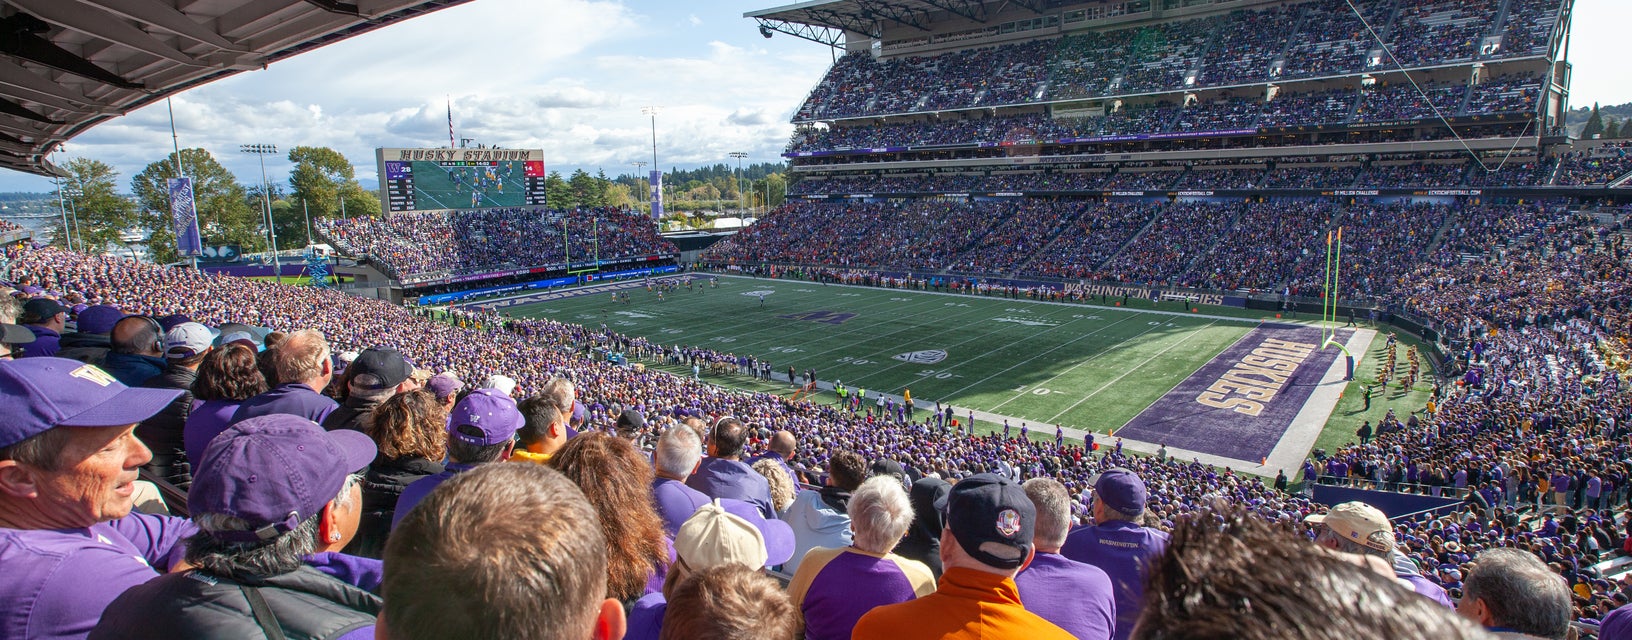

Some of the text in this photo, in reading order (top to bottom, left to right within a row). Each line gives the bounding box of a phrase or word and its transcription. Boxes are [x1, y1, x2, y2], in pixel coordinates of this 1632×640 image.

[400, 150, 530, 161] HUSKY STADIUM
[837, 357, 869, 365] 30
[69, 364, 116, 387] W
[915, 369, 952, 379] 20
[1196, 338, 1317, 417] HUSKIES
[1010, 385, 1050, 395] 10
[1099, 538, 1139, 548] WASHINGTON
[182, 570, 218, 586] Columbia
